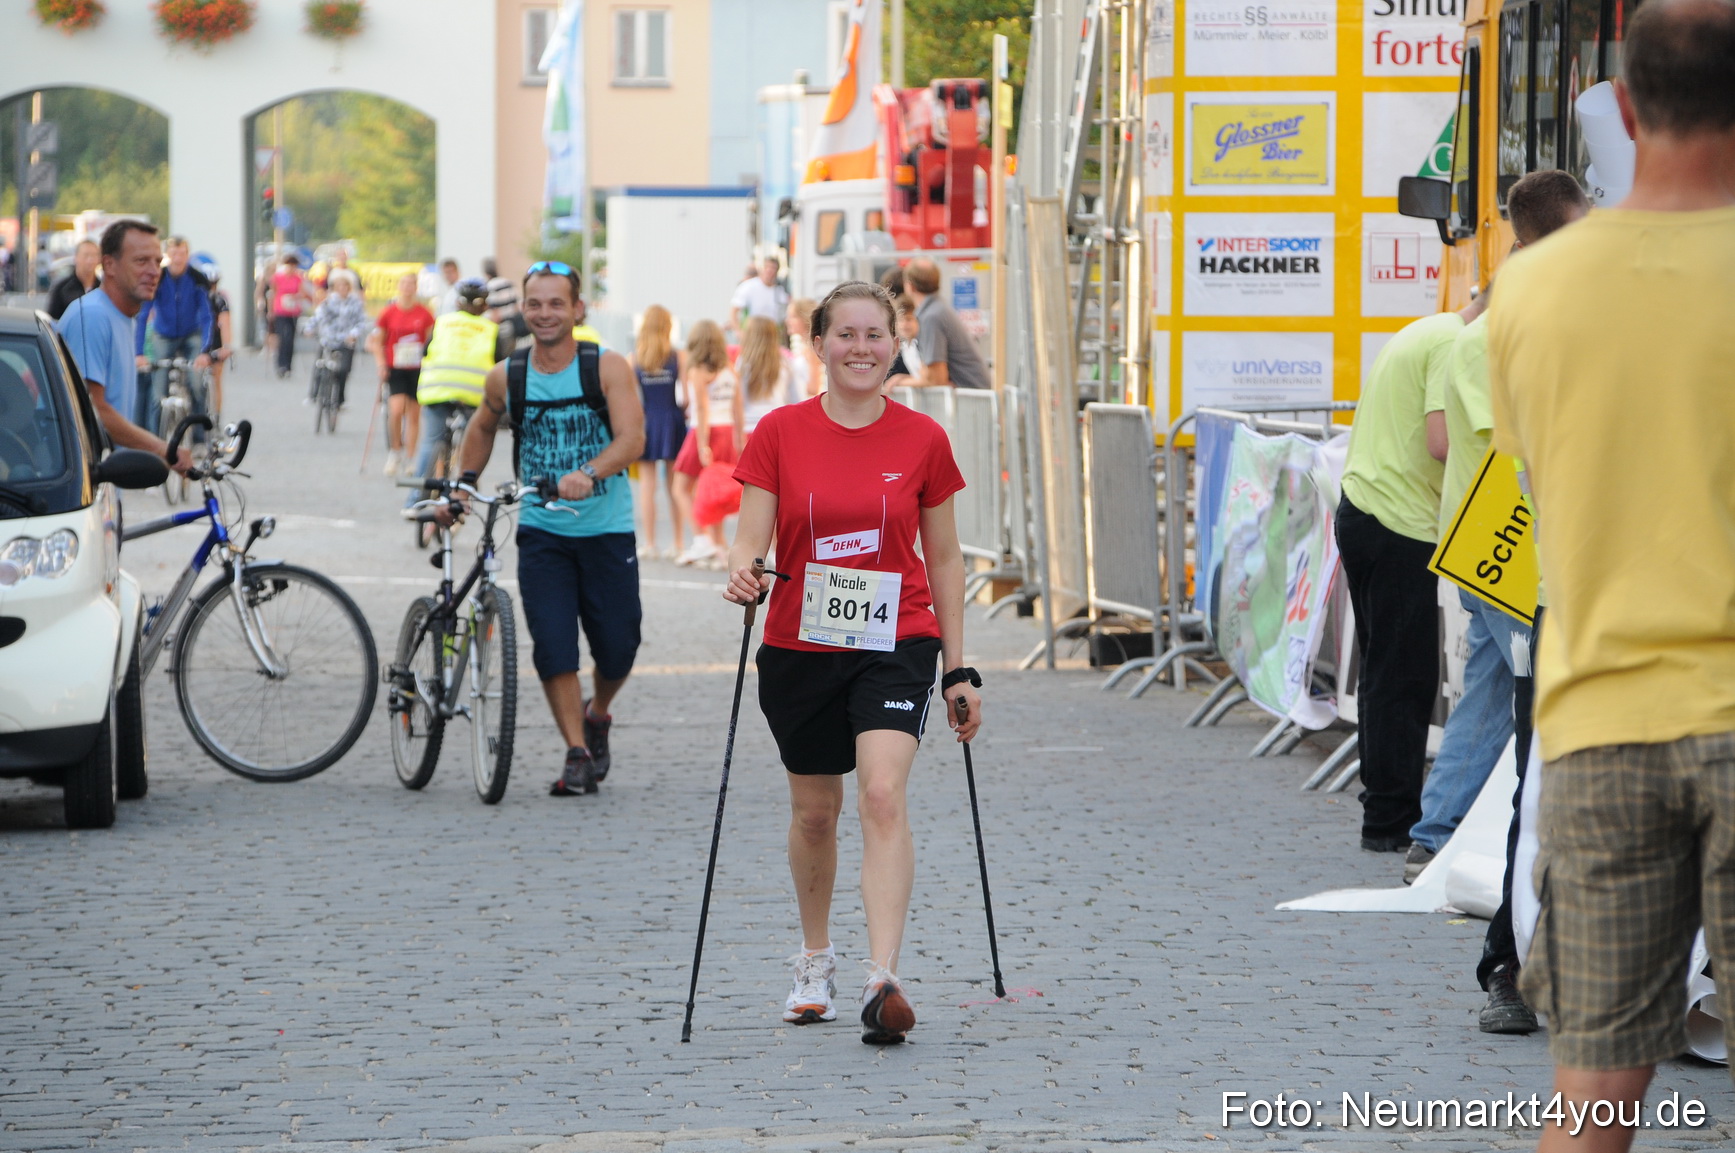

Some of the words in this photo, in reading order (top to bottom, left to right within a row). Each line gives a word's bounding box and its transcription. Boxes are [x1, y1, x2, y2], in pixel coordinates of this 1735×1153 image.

[1194, 12, 1240, 20] RECHTS
[1215, 115, 1305, 162] Glossner
[1261, 141, 1303, 160] Bier
[1217, 238, 1321, 252] INTERSPORT
[1200, 256, 1320, 274] HACKNER
[833, 538, 861, 552] DEHN
[829, 572, 867, 590] Nicole
[806, 591, 813, 603] N
[827, 597, 889, 624] 8014
[856, 636, 893, 646] PFLEIDERER
[884, 700, 909, 711] JAKO
